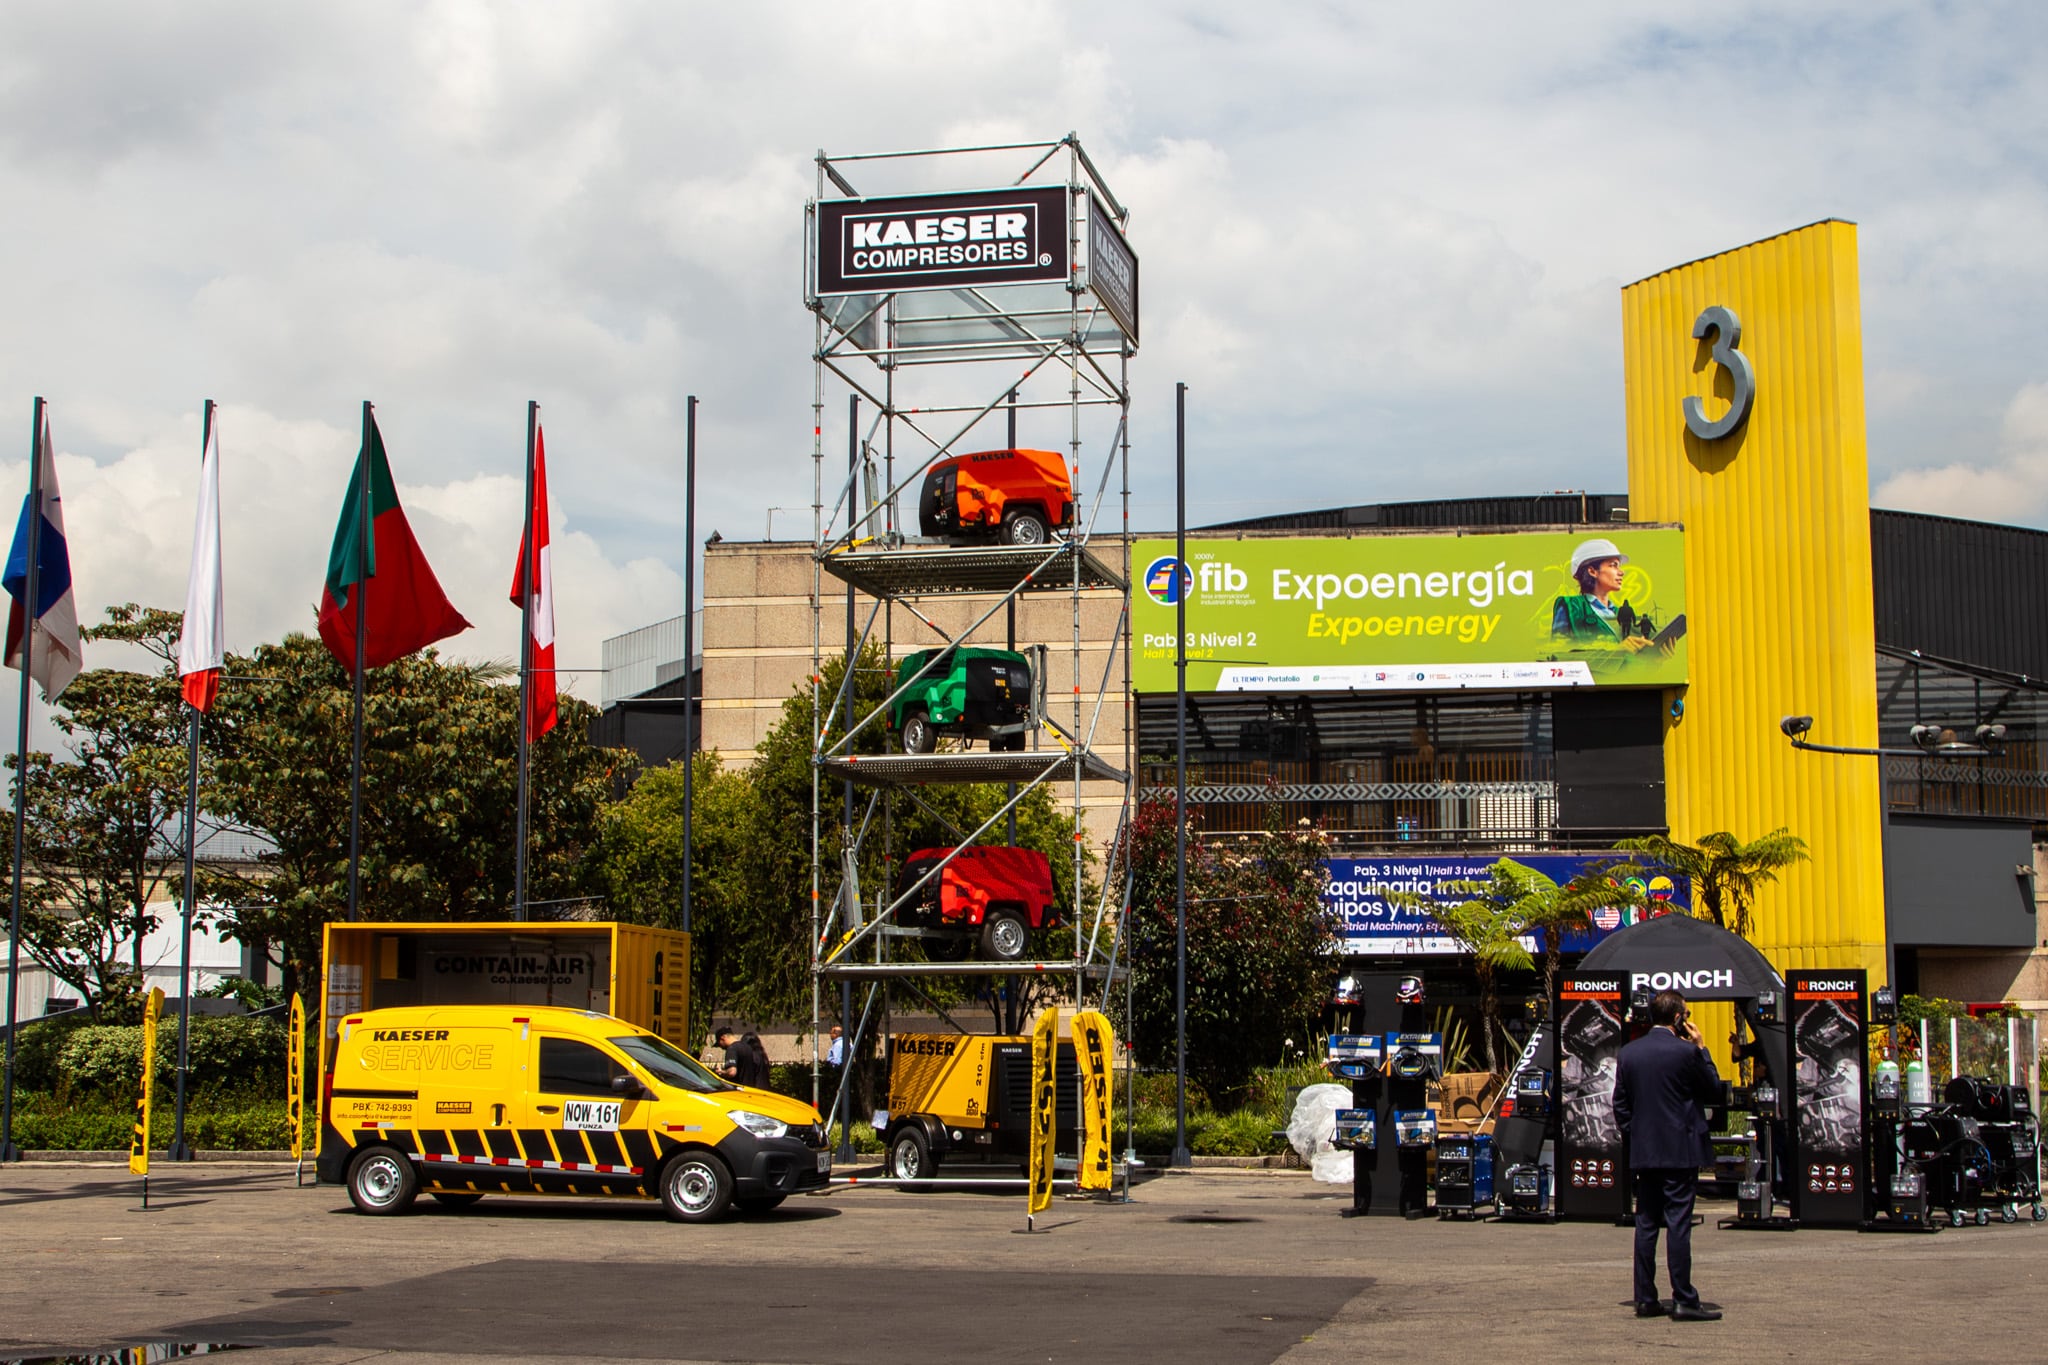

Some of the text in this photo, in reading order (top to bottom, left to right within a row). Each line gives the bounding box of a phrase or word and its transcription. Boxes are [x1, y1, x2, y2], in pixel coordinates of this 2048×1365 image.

[853, 213, 1028, 248] KAESER
[853, 242, 1028, 270] COMPRESORES
[1095, 223, 1130, 293] KAESER
[1682, 306, 1755, 440] 3
[972, 452, 1015, 462] KAESER
[1199, 562, 1248, 592] fib
[1272, 561, 1534, 610] Expoenergía
[1307, 612, 1501, 645] Expoenergy
[1185, 633, 1196, 647] 3
[1200, 632, 1242, 647] Nivel
[1247, 632, 1257, 647] 2
[1143, 649, 1165, 659] Hall
[1167, 649, 1175, 658] 3
[1206, 649, 1214, 658] 2
[1354, 865, 1380, 876] Pab.
[1383, 865, 1390, 876] 3
[1393, 865, 1422, 876] Nivel
[1455, 865, 1462, 876] 3
[1463, 865, 1488, 876] Leve
[1324, 877, 1432, 900] aquinaria
[1387, 902, 1400, 921] y
[1370, 921, 1424, 933] Machinery,
[434, 957, 584, 974] CONTAIN-AIR
[1574, 981, 1617, 991] RONCH
[1631, 969, 1733, 991] RONCH
[1809, 981, 1854, 991] RONCH
[373, 1030, 450, 1041] KAESER
[360, 1044, 494, 1071] SERVICE
[897, 1039, 956, 1056] KAESER
[353, 1103, 413, 1111] PBX: 742-9393
[1086, 1027, 1108, 1172] KAESER
[565, 1103, 619, 1124] NOW 161
